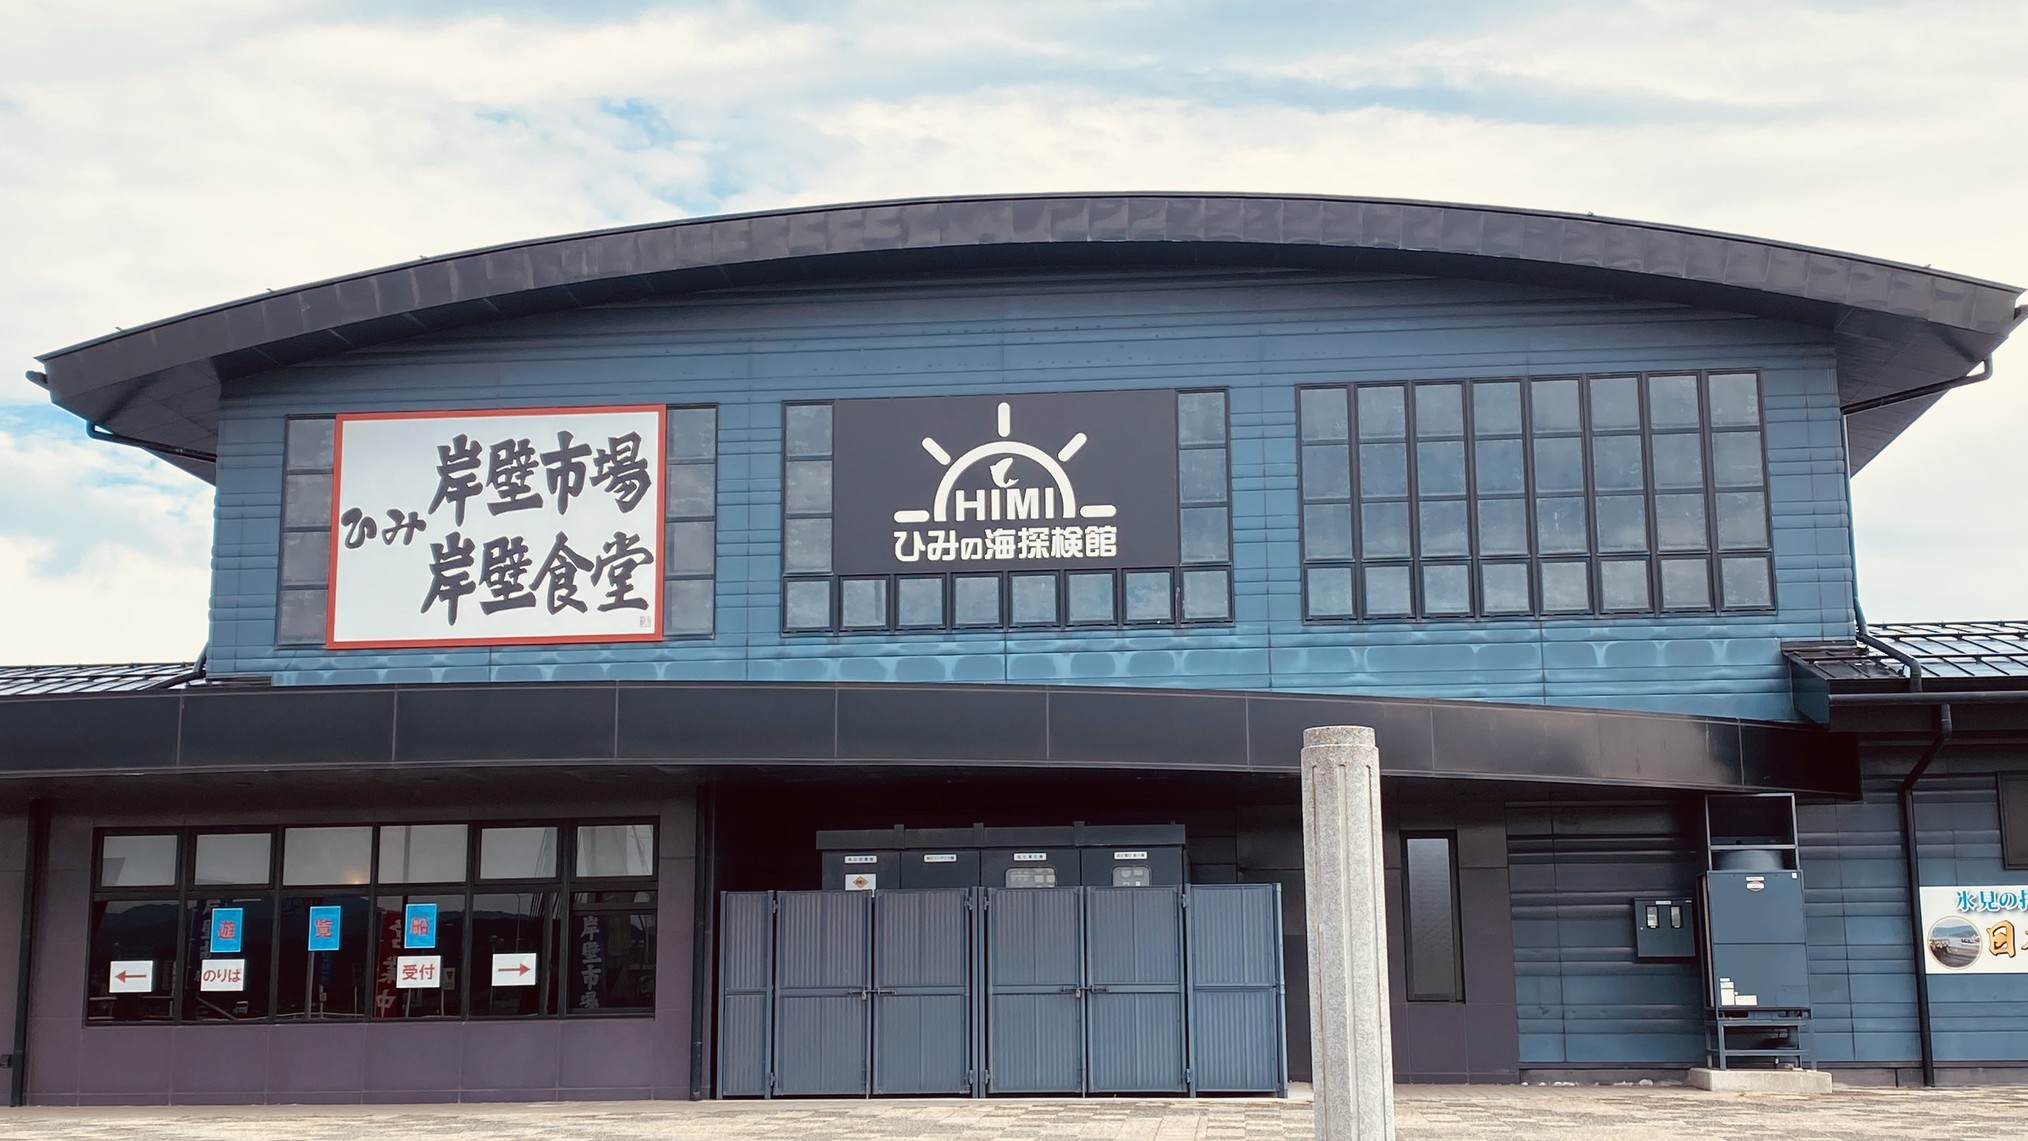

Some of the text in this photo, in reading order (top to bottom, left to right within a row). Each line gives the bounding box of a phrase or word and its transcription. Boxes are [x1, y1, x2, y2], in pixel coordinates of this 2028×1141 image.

[428, 430, 652, 527] 岸壁市場
[955, 487, 1054, 521] HIMI
[341, 507, 426, 549] ひみ
[893, 525, 1117, 562] ひみの海探検館
[420, 531, 654, 626] 岸壁食堂
[1986, 919, 2028, 958] 日
[203, 969, 242, 983] のりば
[402, 963, 435, 981] 受付
